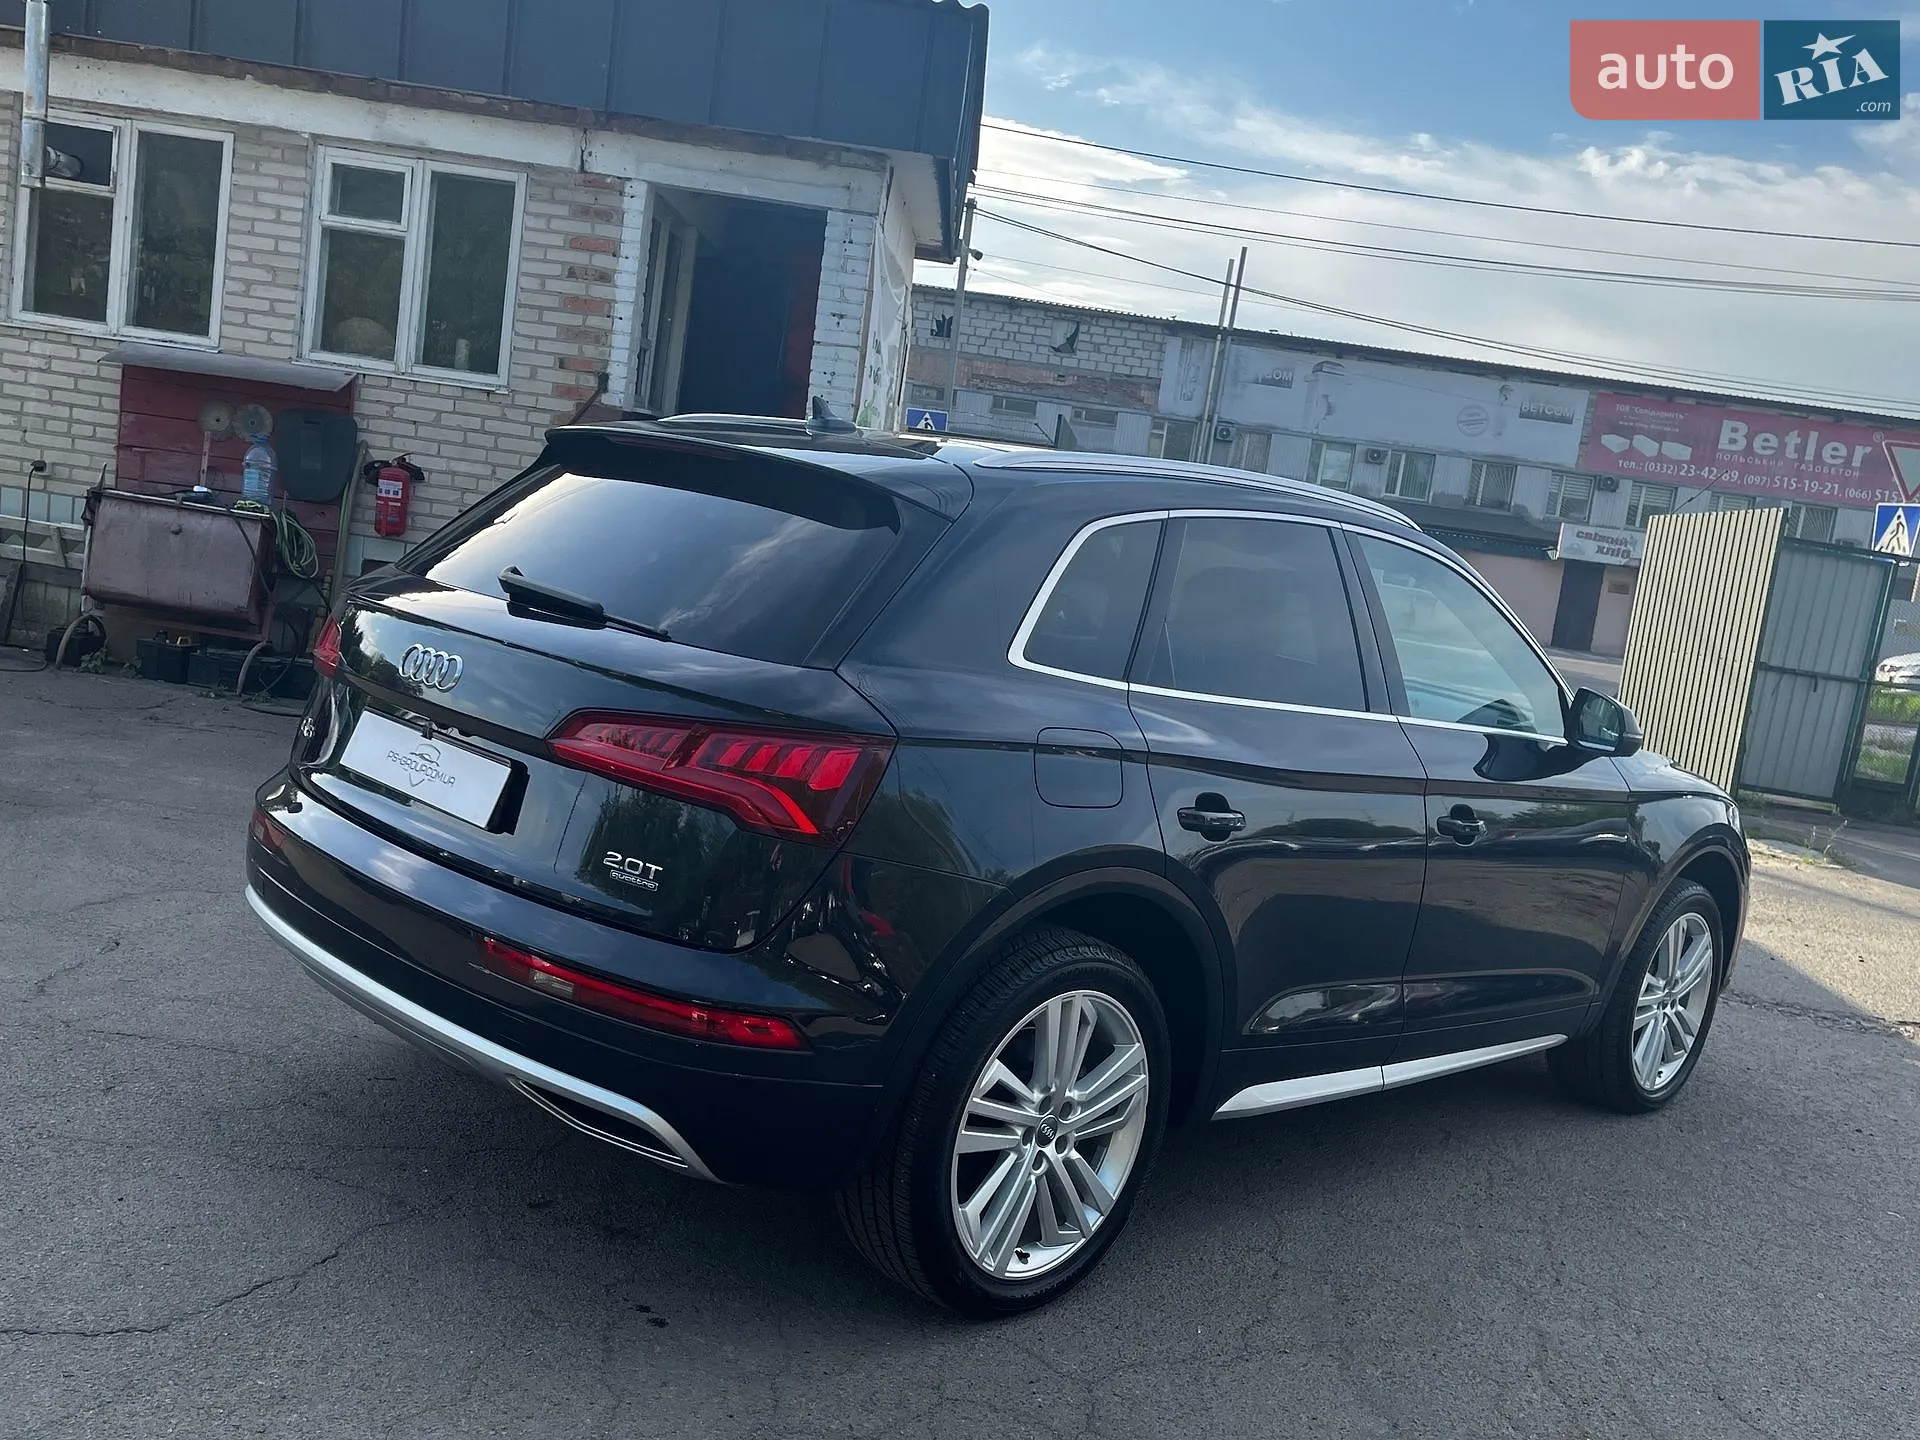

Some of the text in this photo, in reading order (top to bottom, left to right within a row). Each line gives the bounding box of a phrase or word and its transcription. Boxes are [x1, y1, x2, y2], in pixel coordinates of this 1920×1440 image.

[1717, 419, 1873, 467] Betler
[1618, 458, 1643, 470] тел.:
[1645, 462, 1678, 476] (0332)
[1743, 473, 1771, 487] (097)
[1844, 486, 1872, 501] (066)
[1793, 462, 1860, 478] ГАЗОБЕТОН
[603, 851, 664, 880] 2.0T
[611, 871, 656, 890] quattro
